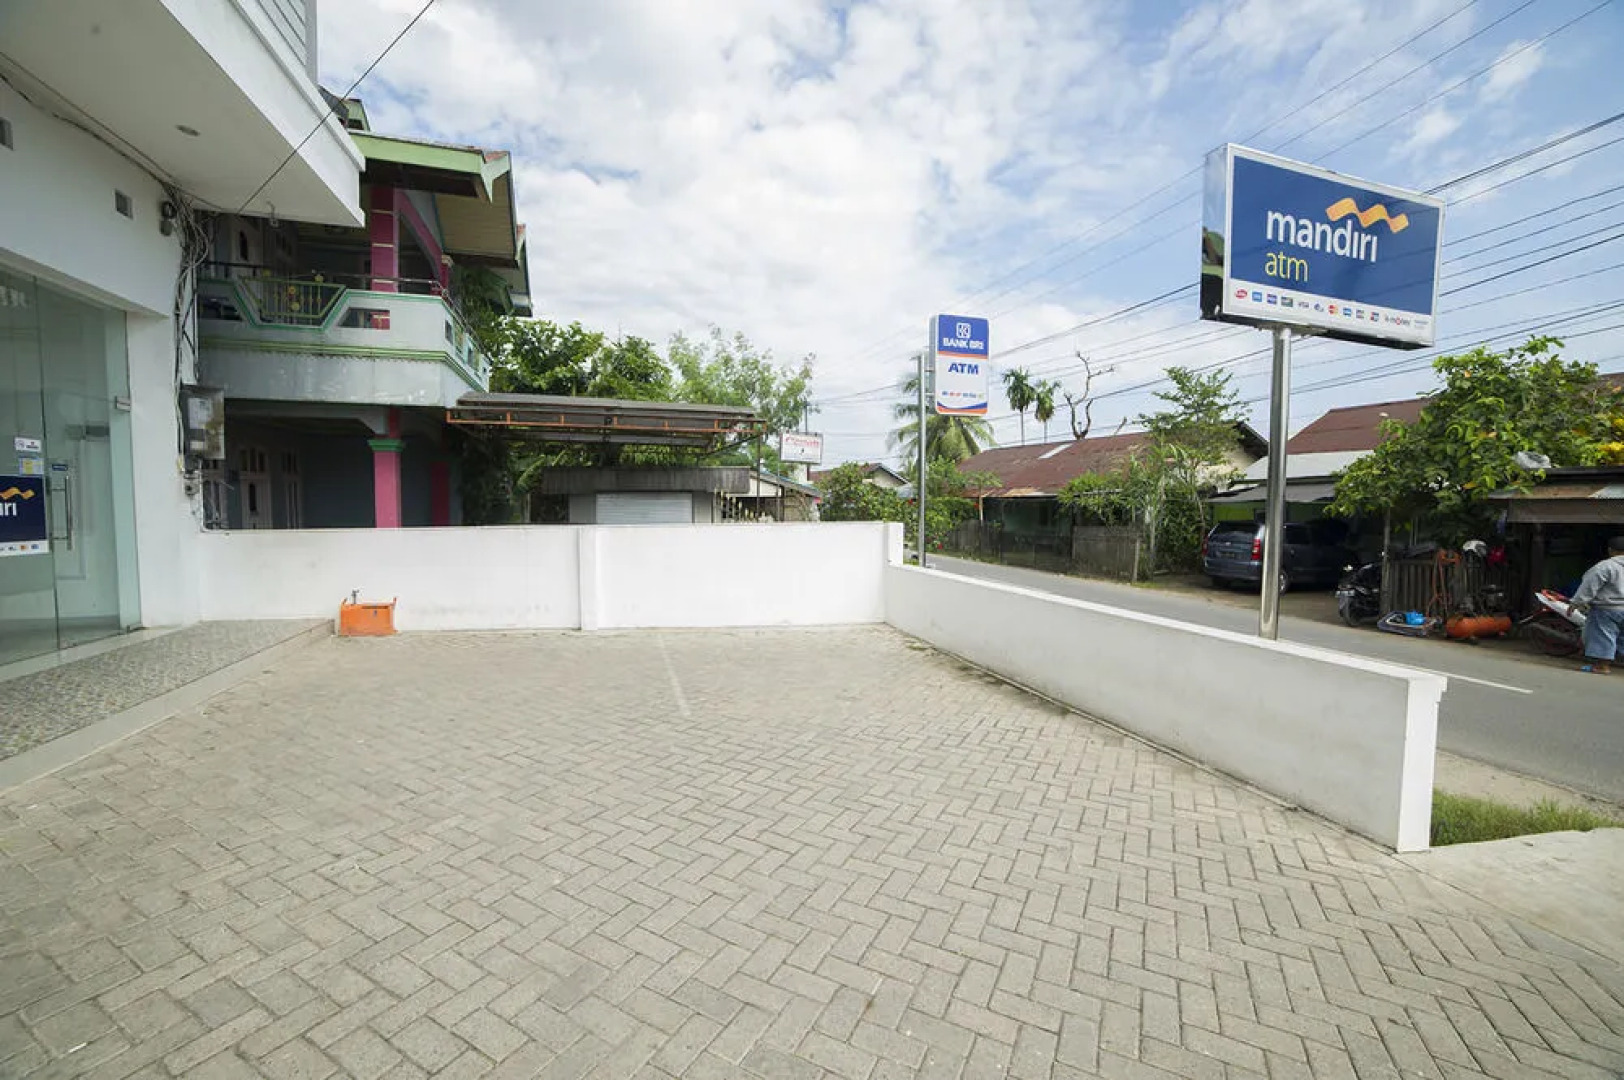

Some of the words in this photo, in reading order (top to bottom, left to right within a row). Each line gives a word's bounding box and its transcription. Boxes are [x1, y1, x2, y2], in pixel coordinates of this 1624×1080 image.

[1266, 210, 1378, 262] mandiri
[1264, 251, 1309, 282] atm
[943, 337, 968, 348] BANK
[948, 362, 979, 375] ATM
